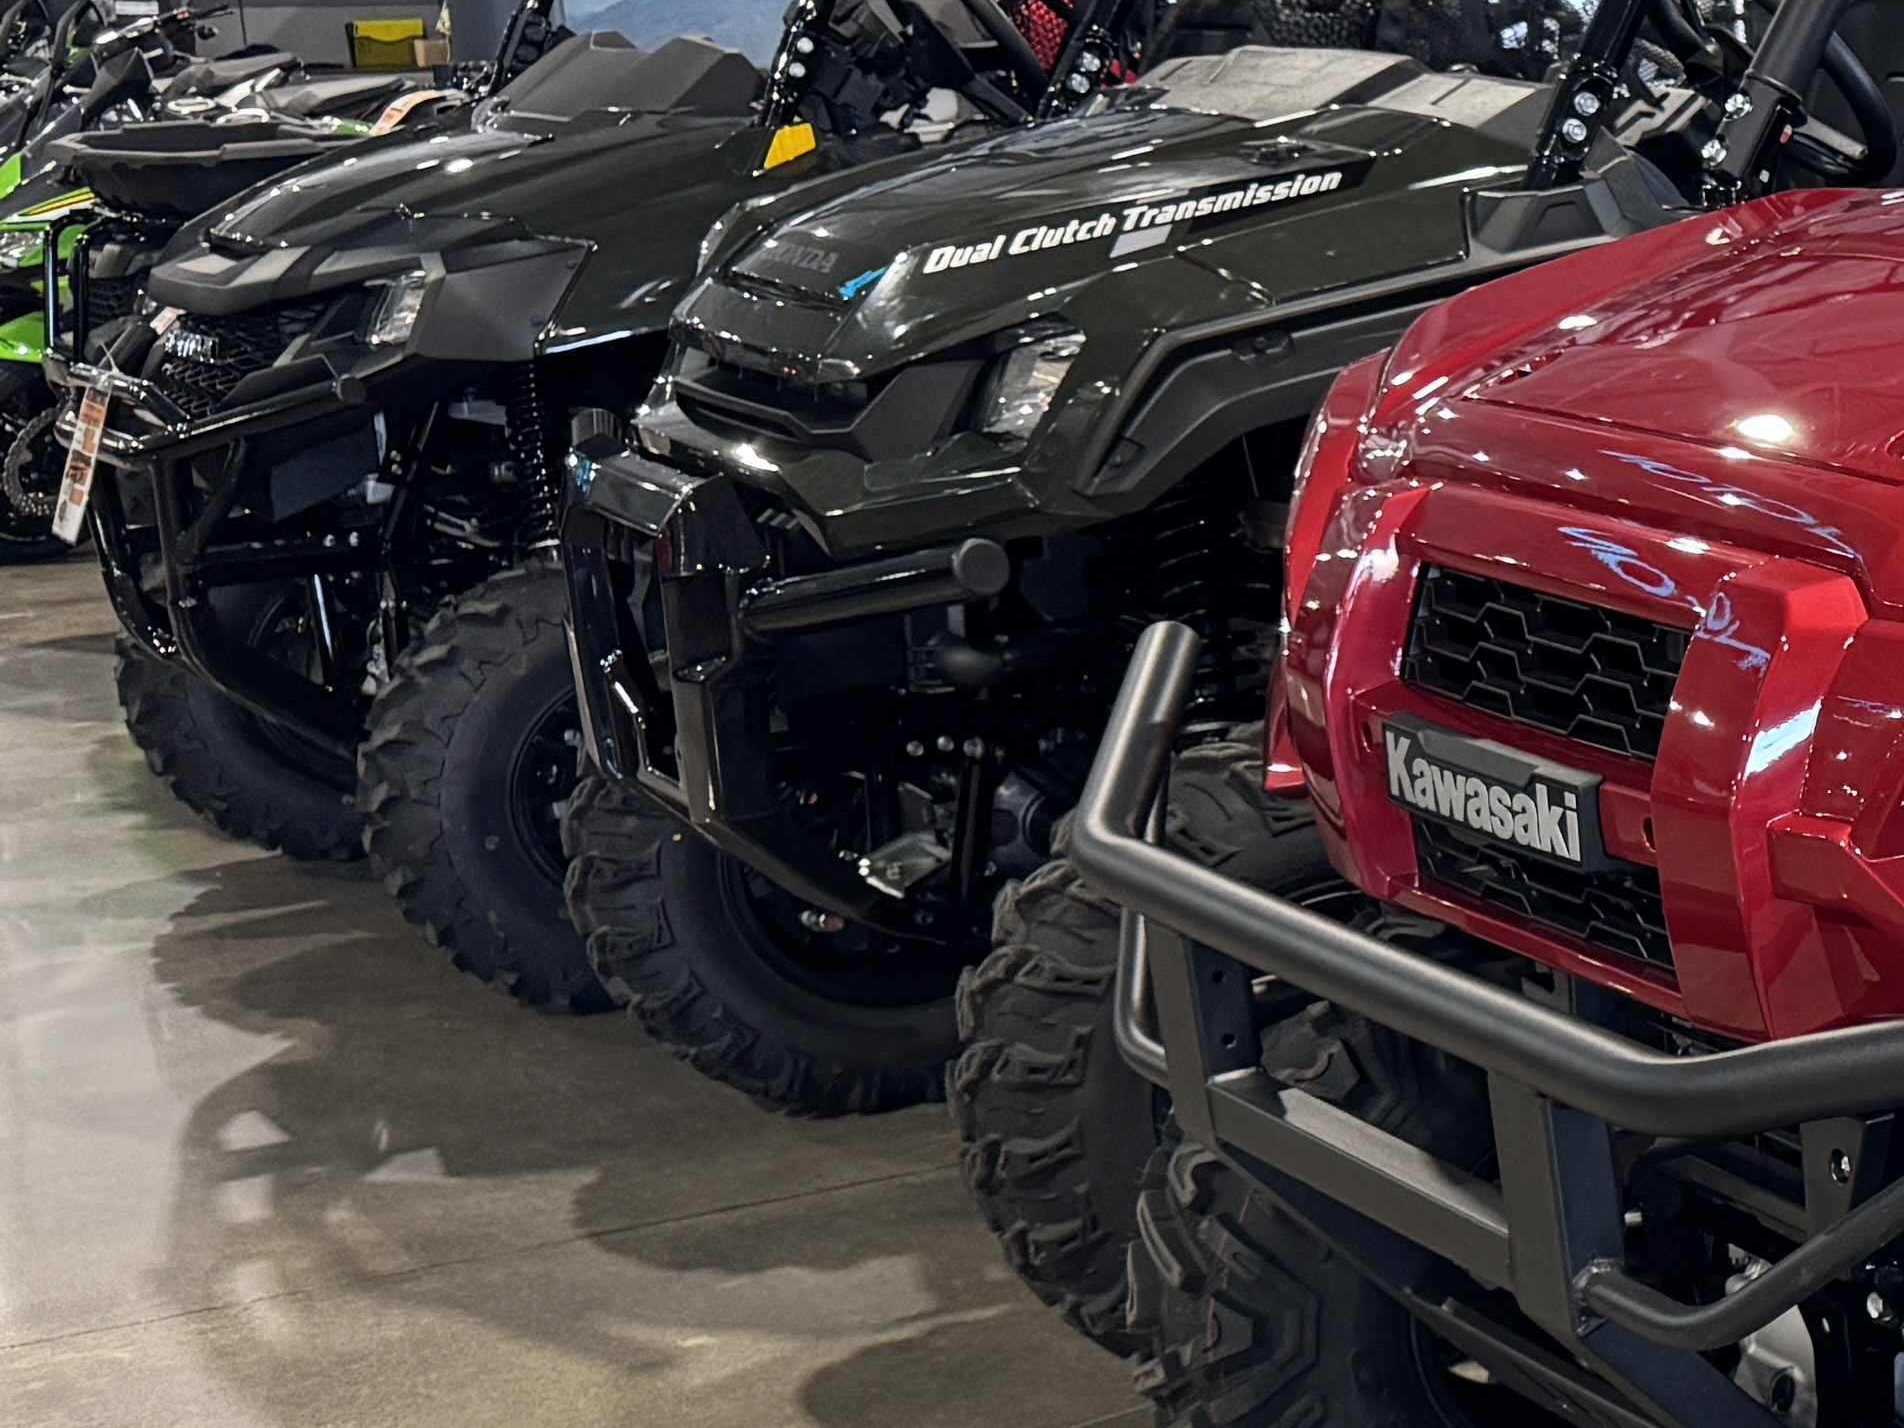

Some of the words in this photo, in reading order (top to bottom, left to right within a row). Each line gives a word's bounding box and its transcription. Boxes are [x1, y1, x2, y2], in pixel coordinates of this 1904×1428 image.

[923, 234, 1006, 275] Dual
[1008, 213, 1117, 257] Clutch
[1120, 171, 1343, 231] Transmission
[1385, 731, 1581, 862] Kawasaki
